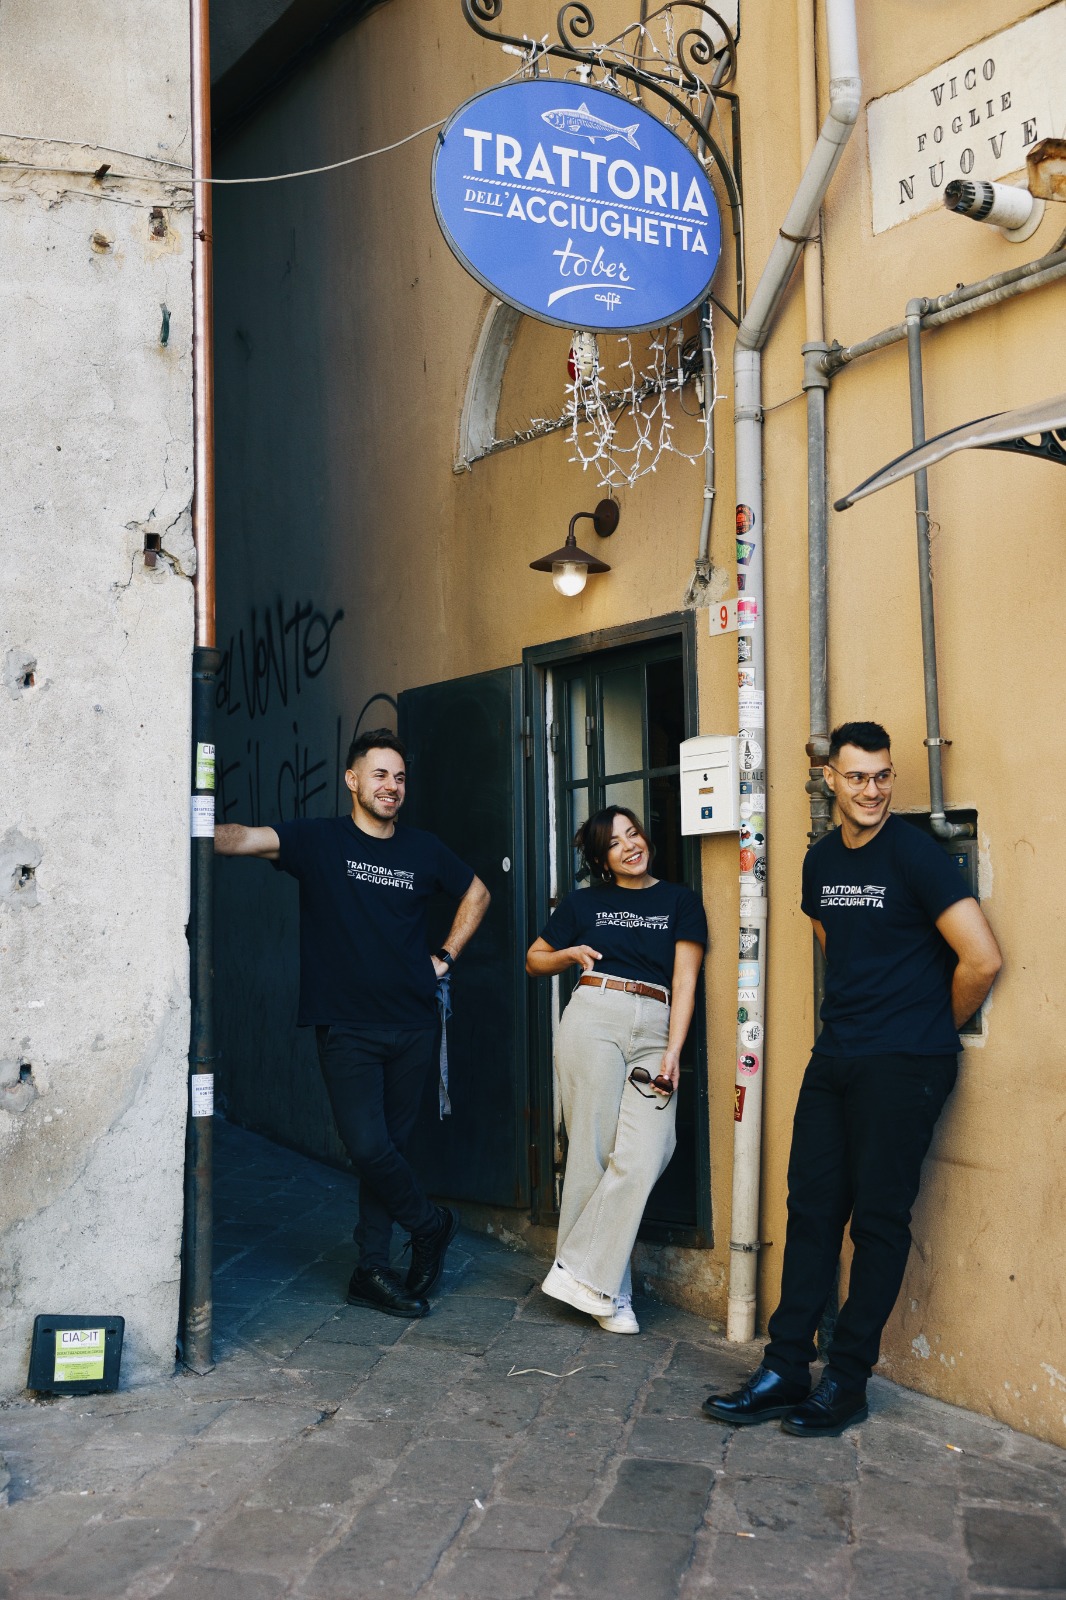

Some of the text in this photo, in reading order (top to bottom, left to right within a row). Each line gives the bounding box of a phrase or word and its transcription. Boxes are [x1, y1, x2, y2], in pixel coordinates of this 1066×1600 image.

[930, 58, 995, 106] VICO
[917, 91, 1012, 152] FOGLIE
[463, 128, 709, 216] TRATTORIA
[898, 117, 1038, 205] NUOVE
[552, 237, 630, 282] tober
[719, 605, 729, 630] 9
[739, 771, 764, 781] LOCALE
[346, 860, 394, 876] TRATTORIA
[822, 885, 862, 895] TRATTORIA
[595, 911, 644, 921] TRATTORIA
